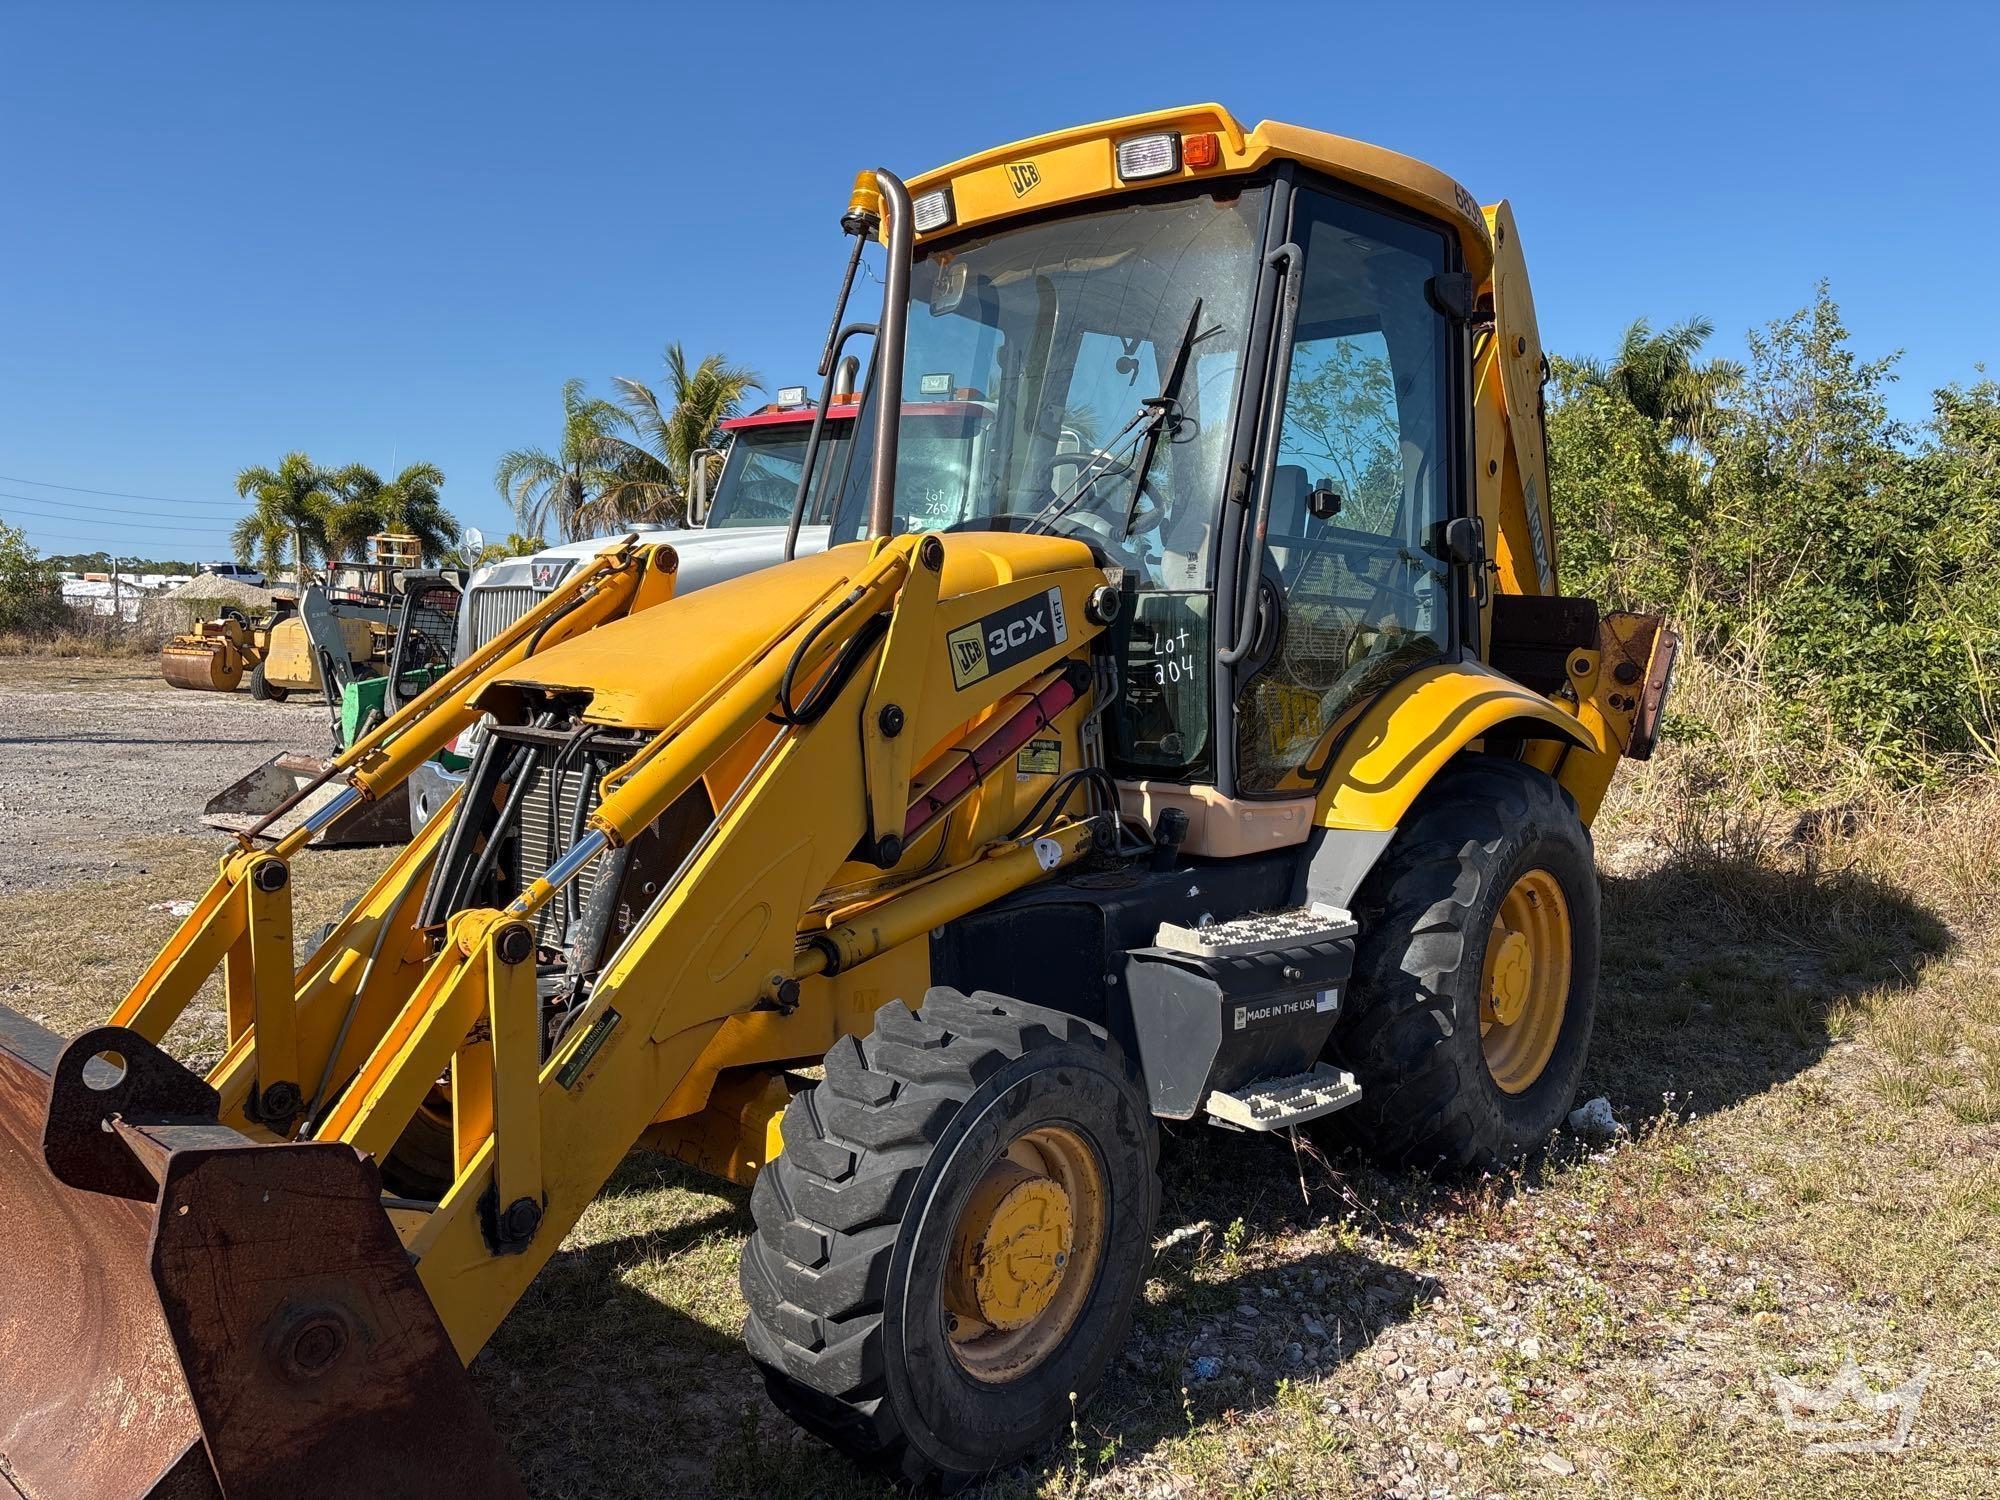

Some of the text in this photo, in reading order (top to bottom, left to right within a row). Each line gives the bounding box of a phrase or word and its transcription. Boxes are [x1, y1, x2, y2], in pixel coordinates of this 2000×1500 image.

[1010, 164, 1039, 194] JCB
[925, 502, 949, 515] 760
[1052, 600, 1064, 632] 14FT
[957, 610, 1048, 672] JCB 3CX
[1154, 627, 1190, 656] Lot
[1153, 654, 1194, 685] 204
[1247, 1007, 1271, 1022] MADE
[1272, 1005, 1282, 1016] IN
[1283, 1002, 1299, 1014] THE
[1299, 999, 1316, 1010] USA
[578, 1021, 606, 1056] WARNING
